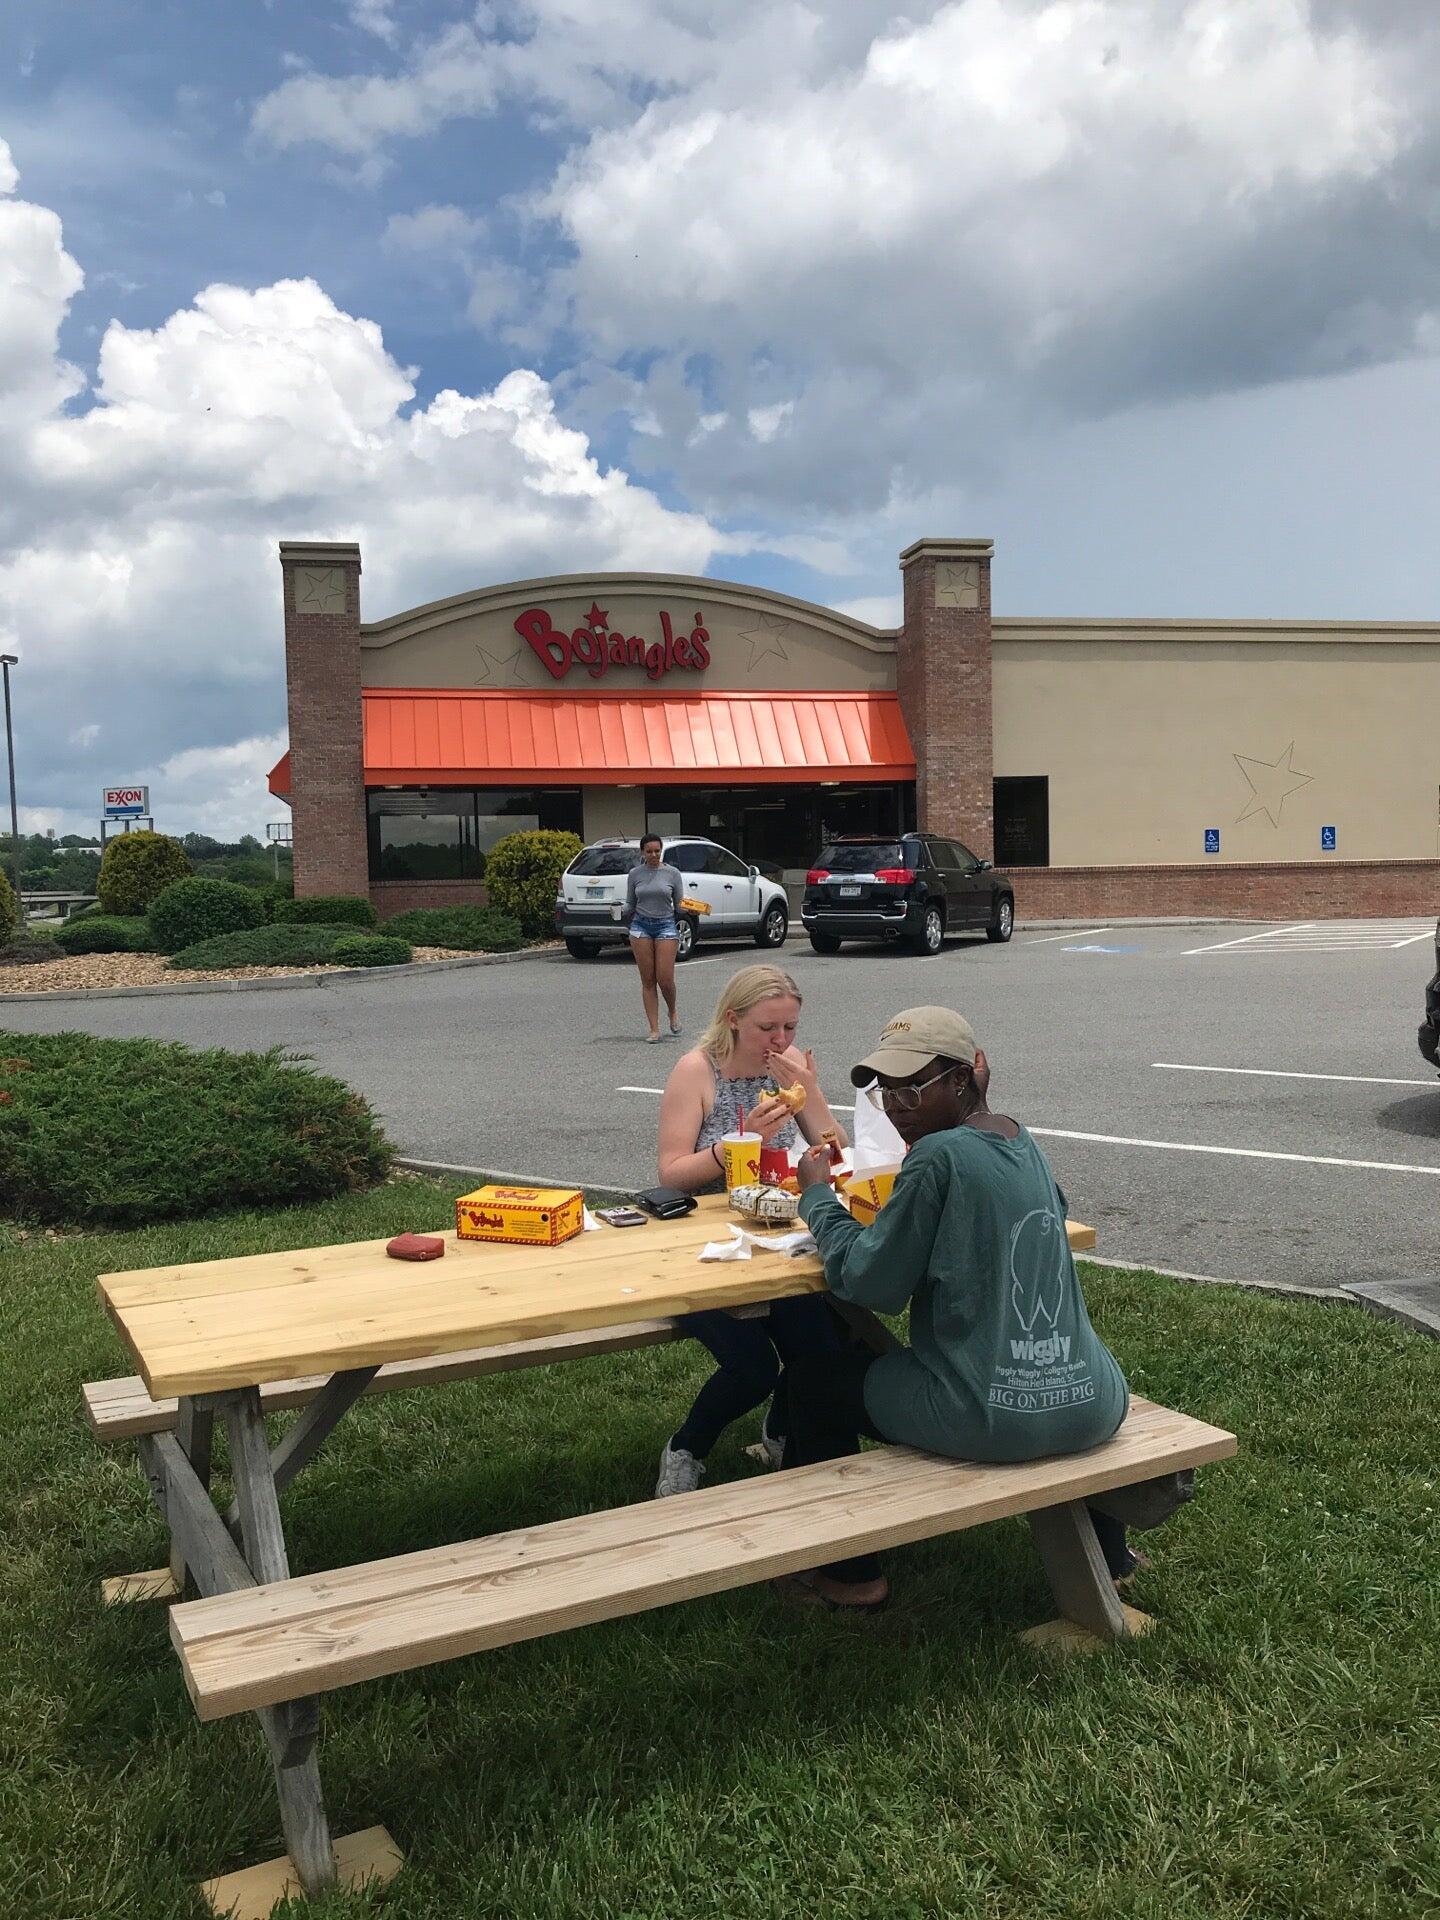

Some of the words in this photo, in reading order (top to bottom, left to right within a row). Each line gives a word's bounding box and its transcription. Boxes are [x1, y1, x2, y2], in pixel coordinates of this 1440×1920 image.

[107, 790, 142, 806] EXXON
[1010, 1330, 1071, 1367] wiggly
[1007, 1376, 1029, 1387] Hilton
[988, 1387, 1014, 1406] BIG
[1017, 1392, 1039, 1409] ON
[1040, 1388, 1069, 1407] THE
[1071, 1381, 1095, 1401] PIG
